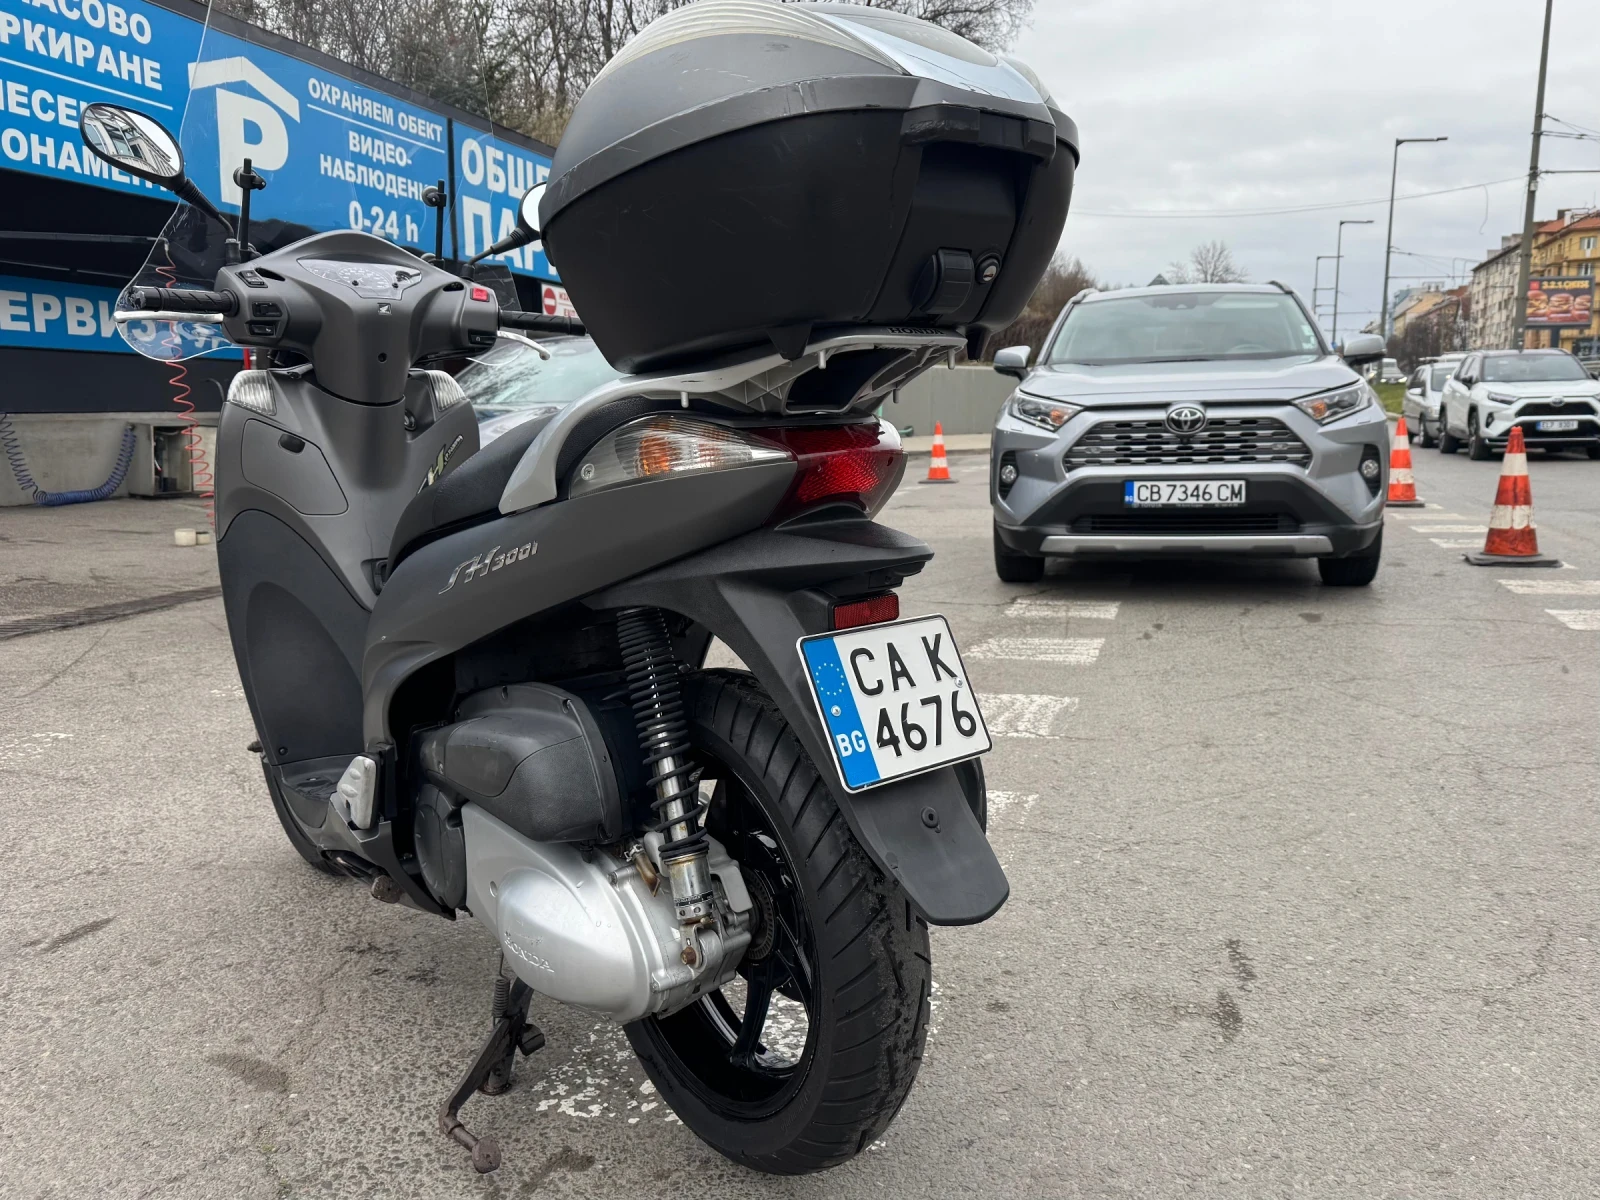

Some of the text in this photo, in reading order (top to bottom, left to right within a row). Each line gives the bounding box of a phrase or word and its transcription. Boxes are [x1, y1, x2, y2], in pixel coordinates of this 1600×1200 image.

[308, 78, 443, 143] ОХРАНЯЕМ ОБЕКТ
[349, 131, 412, 167] ВИДЕО-
[349, 201, 419, 243] 0-24 h
[889, 327, 944, 335] HONDA
[1137, 484, 1243, 502] CB 7346 CM
[850, 633, 960, 696] CA K
[876, 690, 976, 757] 4676
[836, 730, 866, 757] BG
